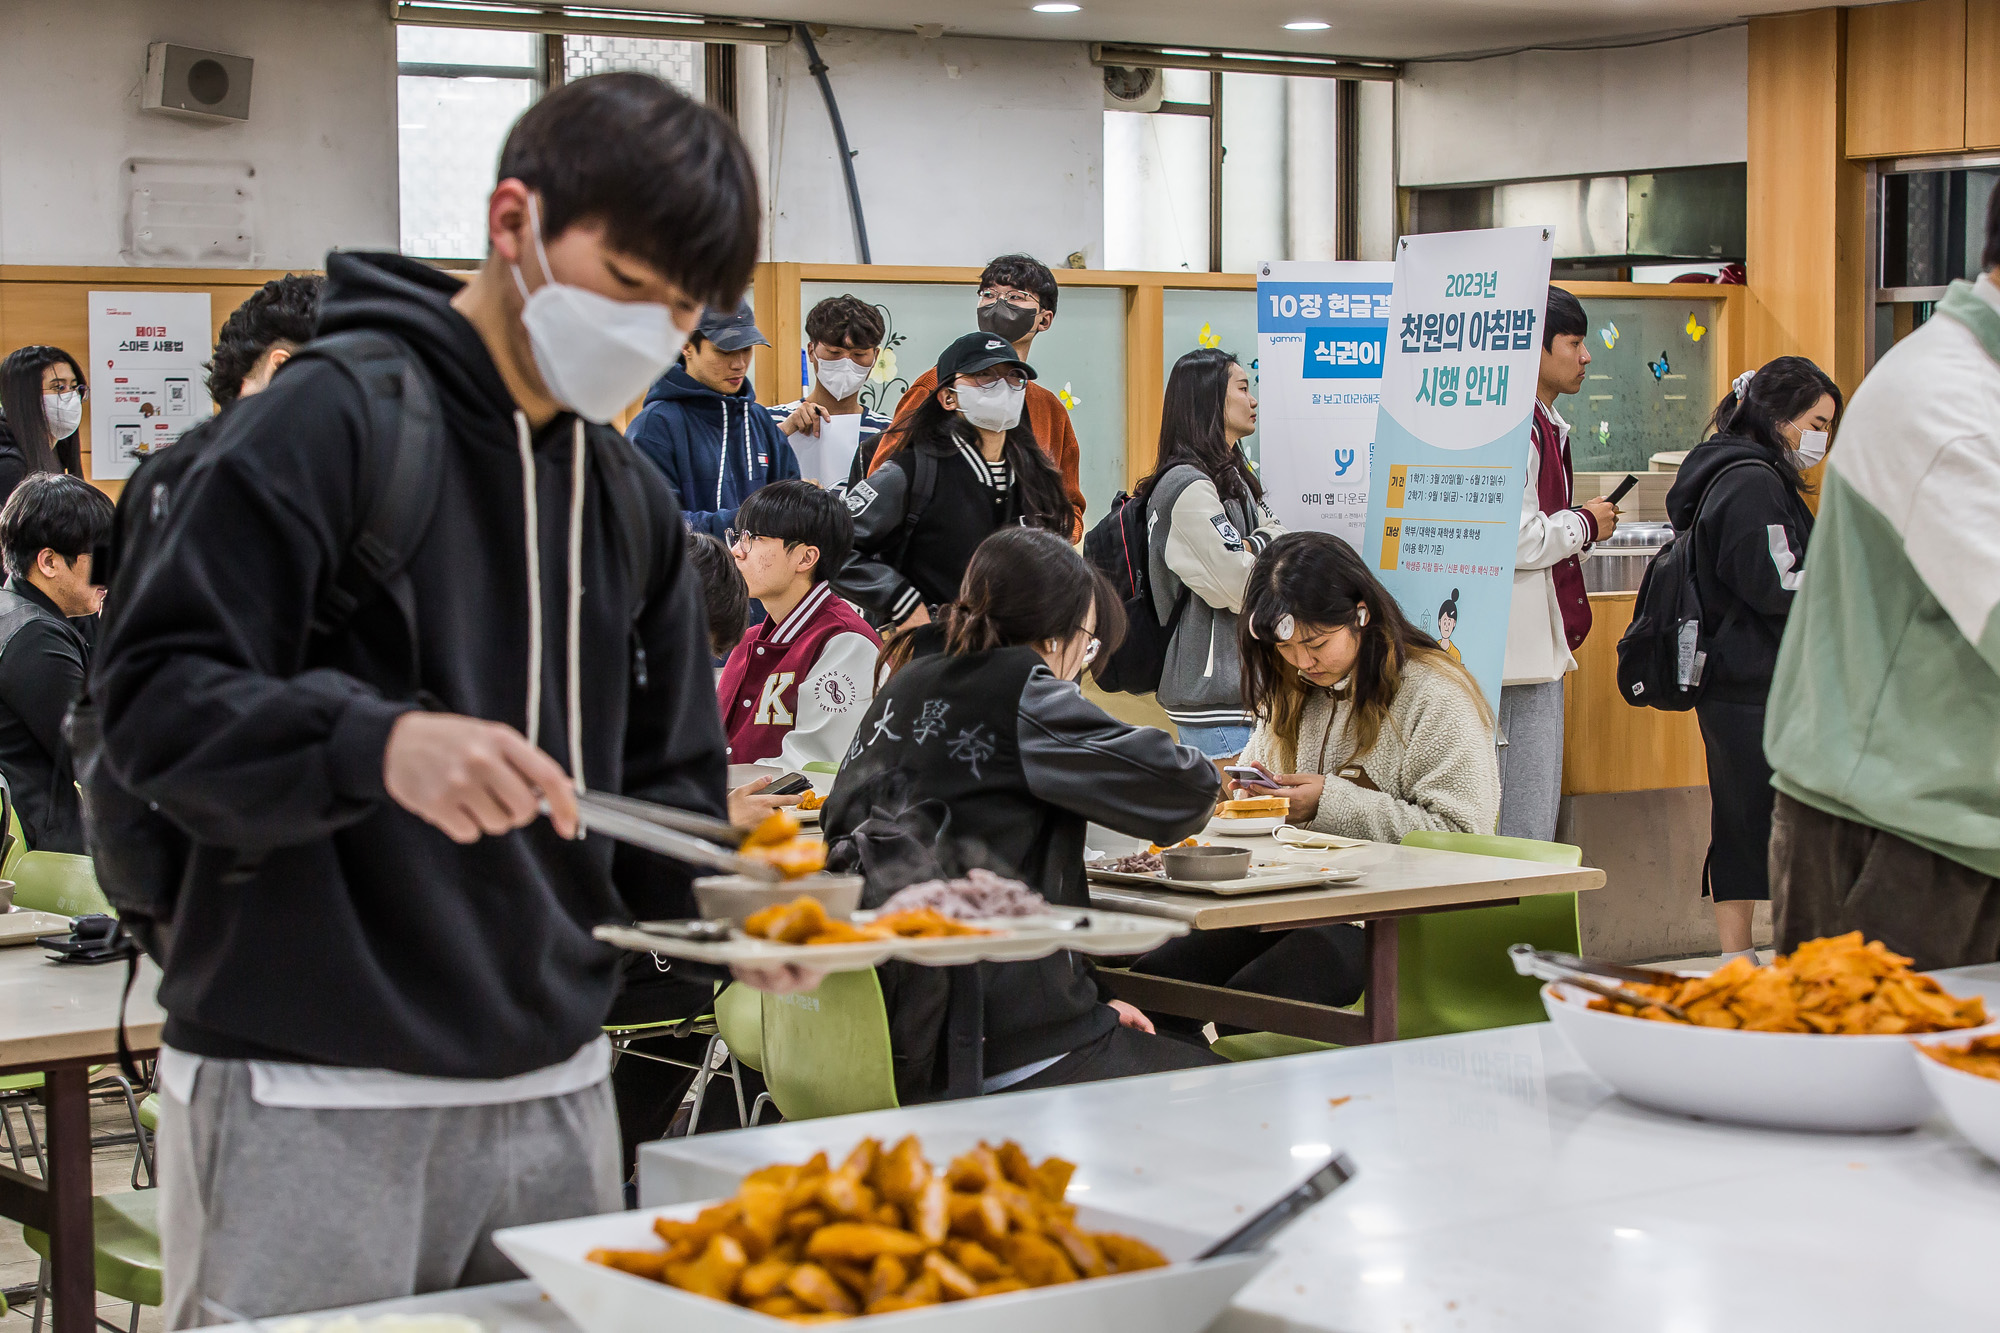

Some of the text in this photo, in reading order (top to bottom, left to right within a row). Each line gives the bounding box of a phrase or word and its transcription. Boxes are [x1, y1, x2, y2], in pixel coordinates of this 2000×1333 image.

[1445, 270, 1498, 298] 2023년
[1269, 293, 1323, 319] 10장
[135, 326, 167, 337] 페이코
[1399, 308, 1537, 353] 천원의 아침밥
[119, 340, 184, 352] 스마트 사용법
[1269, 336, 1303, 346] yammi
[1313, 341, 1380, 365] 식권이
[1415, 365, 1509, 406] 시행 안내
[1312, 393, 1321, 404] 잘
[1323, 393, 1342, 405] 보고
[1391, 476, 1405, 487] 기간
[1410, 473, 1425, 484] 1학기
[1430, 473, 1440, 485] 3월
[1440, 474, 1464, 486] 20일(월)
[1470, 474, 1480, 486] 6월
[1481, 474, 1506, 487] 21일(수)
[1301, 492, 1368, 505] 야미 앱 다운로
[1407, 490, 1424, 501] 2학기
[1428, 490, 1438, 502] 9월
[1439, 491, 1459, 503] 1일(금)
[1465, 492, 1479, 503] 12월
[1479, 492, 1504, 504] 21일(목)
[1385, 526, 1400, 537] 대상
[1404, 525, 1480, 540] 학부/대학원 재학생 및 휴학생
[1402, 542, 1445, 556] (이용 학기 기준)
[1405, 561, 1421, 572] 학생증
[1421, 561, 1433, 573] 지참
[1433, 562, 1445, 573] 필수
[814, 670, 856, 706] LIBERTAS JUSTITIA
[754, 671, 796, 726] K
[819, 702, 848, 714] VERITAS
